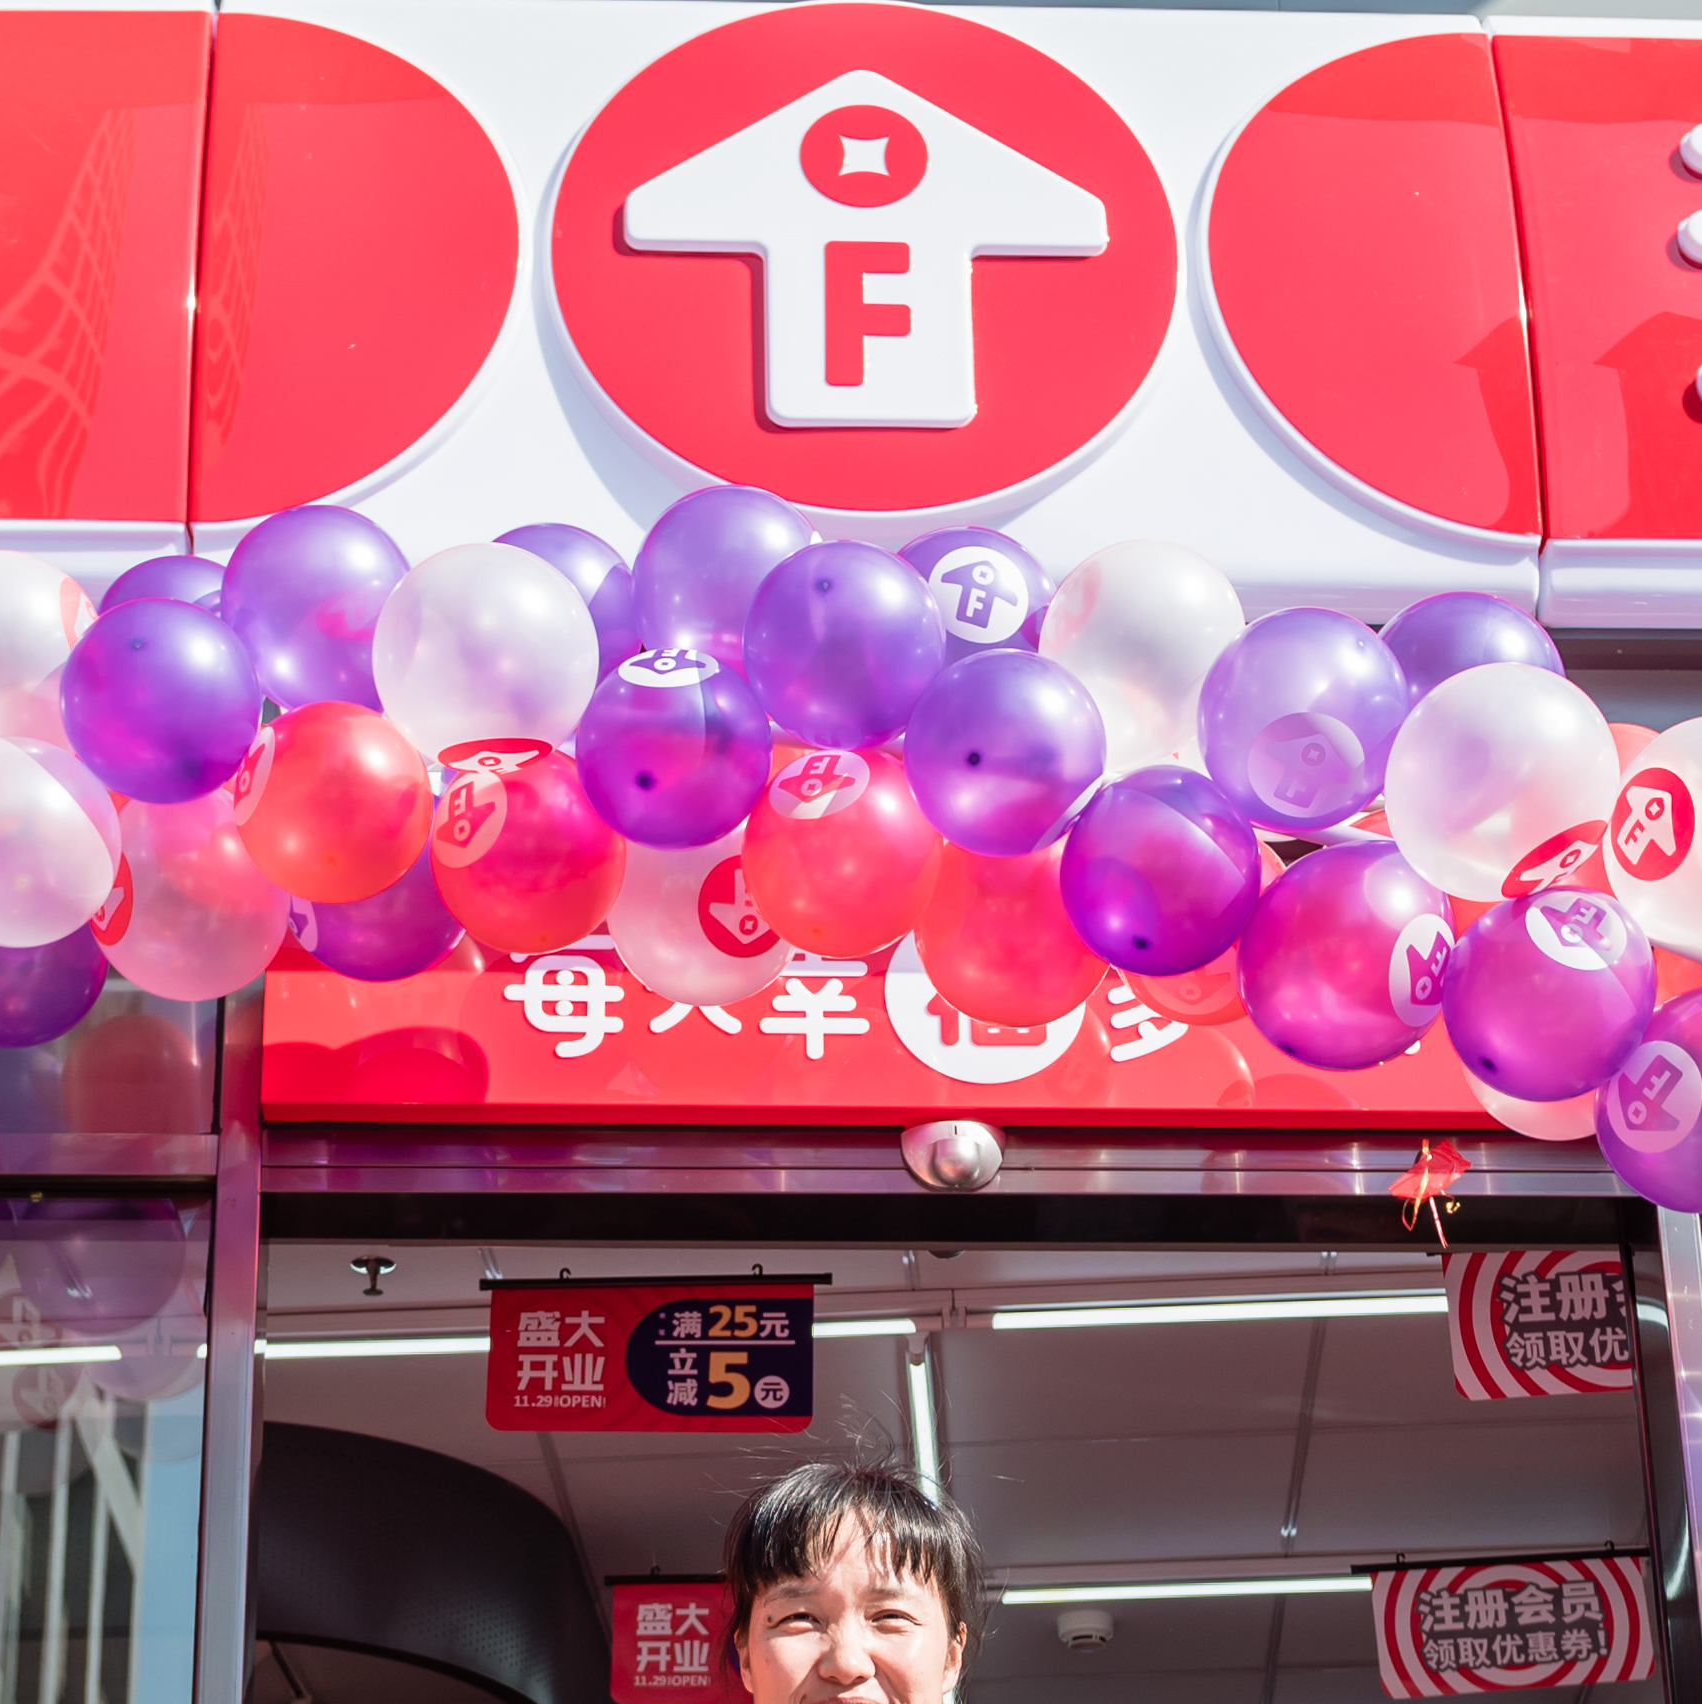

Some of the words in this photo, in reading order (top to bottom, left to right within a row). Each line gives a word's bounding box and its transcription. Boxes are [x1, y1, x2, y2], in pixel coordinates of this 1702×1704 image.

[516, 1310, 605, 1348] 盛大
[671, 1304, 790, 1338] 满25元
[1505, 1326, 1629, 1369] 领取优
[516, 1353, 605, 1391] 开业
[635, 1602, 710, 1637] 盛大
[1418, 1580, 1605, 1633] 注册会员
[635, 1639, 710, 1673] 开业
[1422, 1628, 1608, 1671] 领取优惠券!
